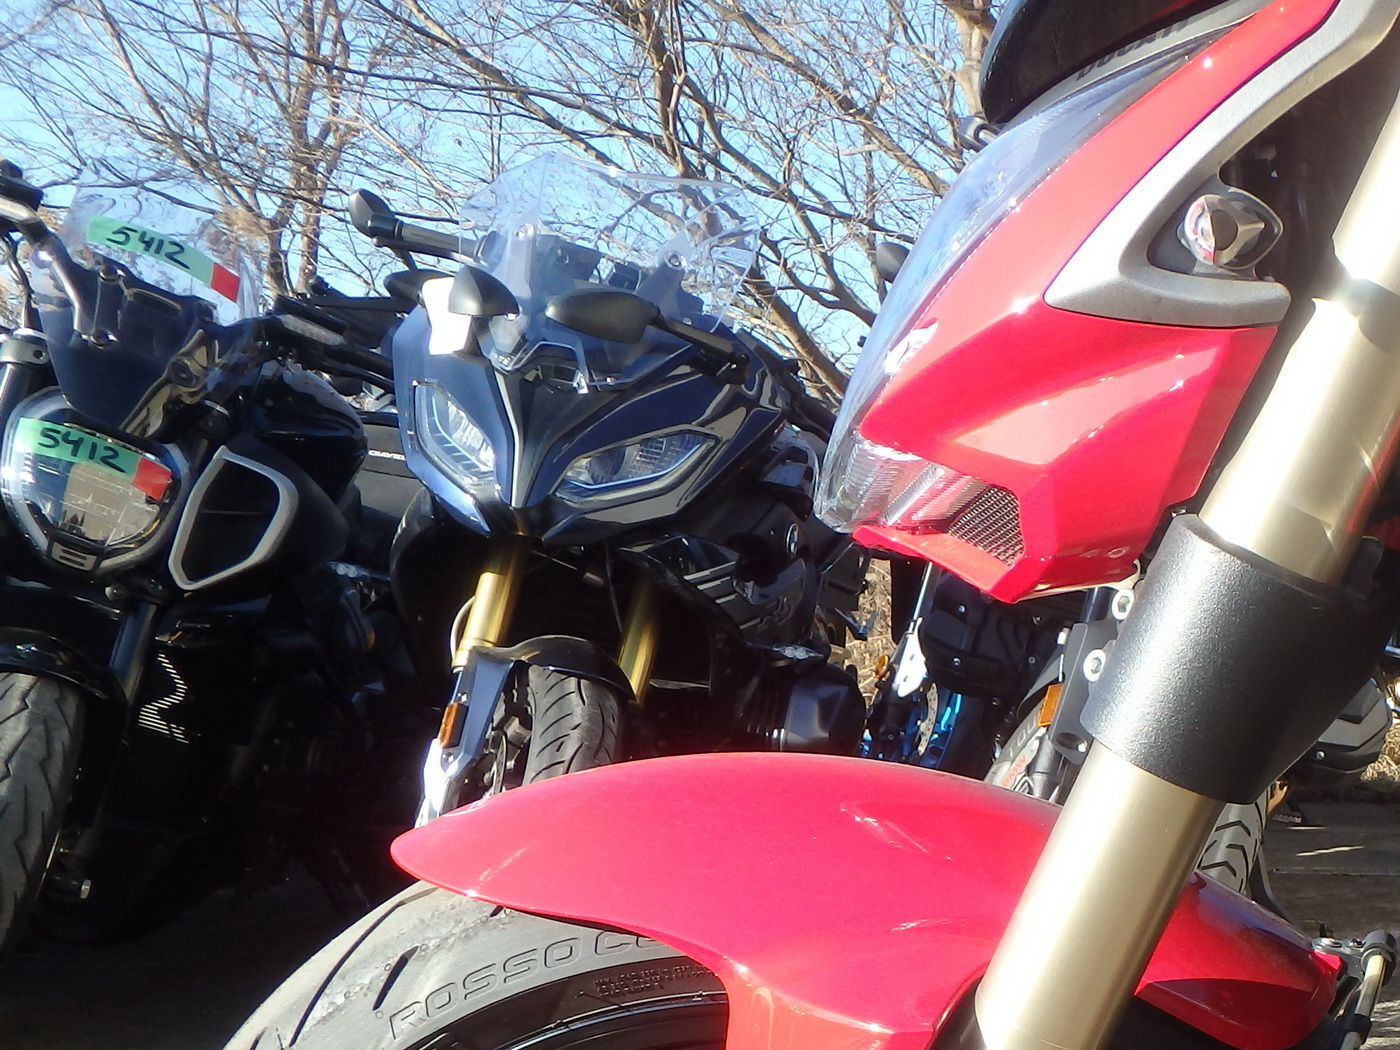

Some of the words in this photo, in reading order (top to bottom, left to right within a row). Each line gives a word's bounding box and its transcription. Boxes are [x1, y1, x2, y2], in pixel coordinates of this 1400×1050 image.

[105, 225, 191, 271] 5412
[37, 425, 126, 473] 5412
[388, 937, 582, 1041] ROSSO
